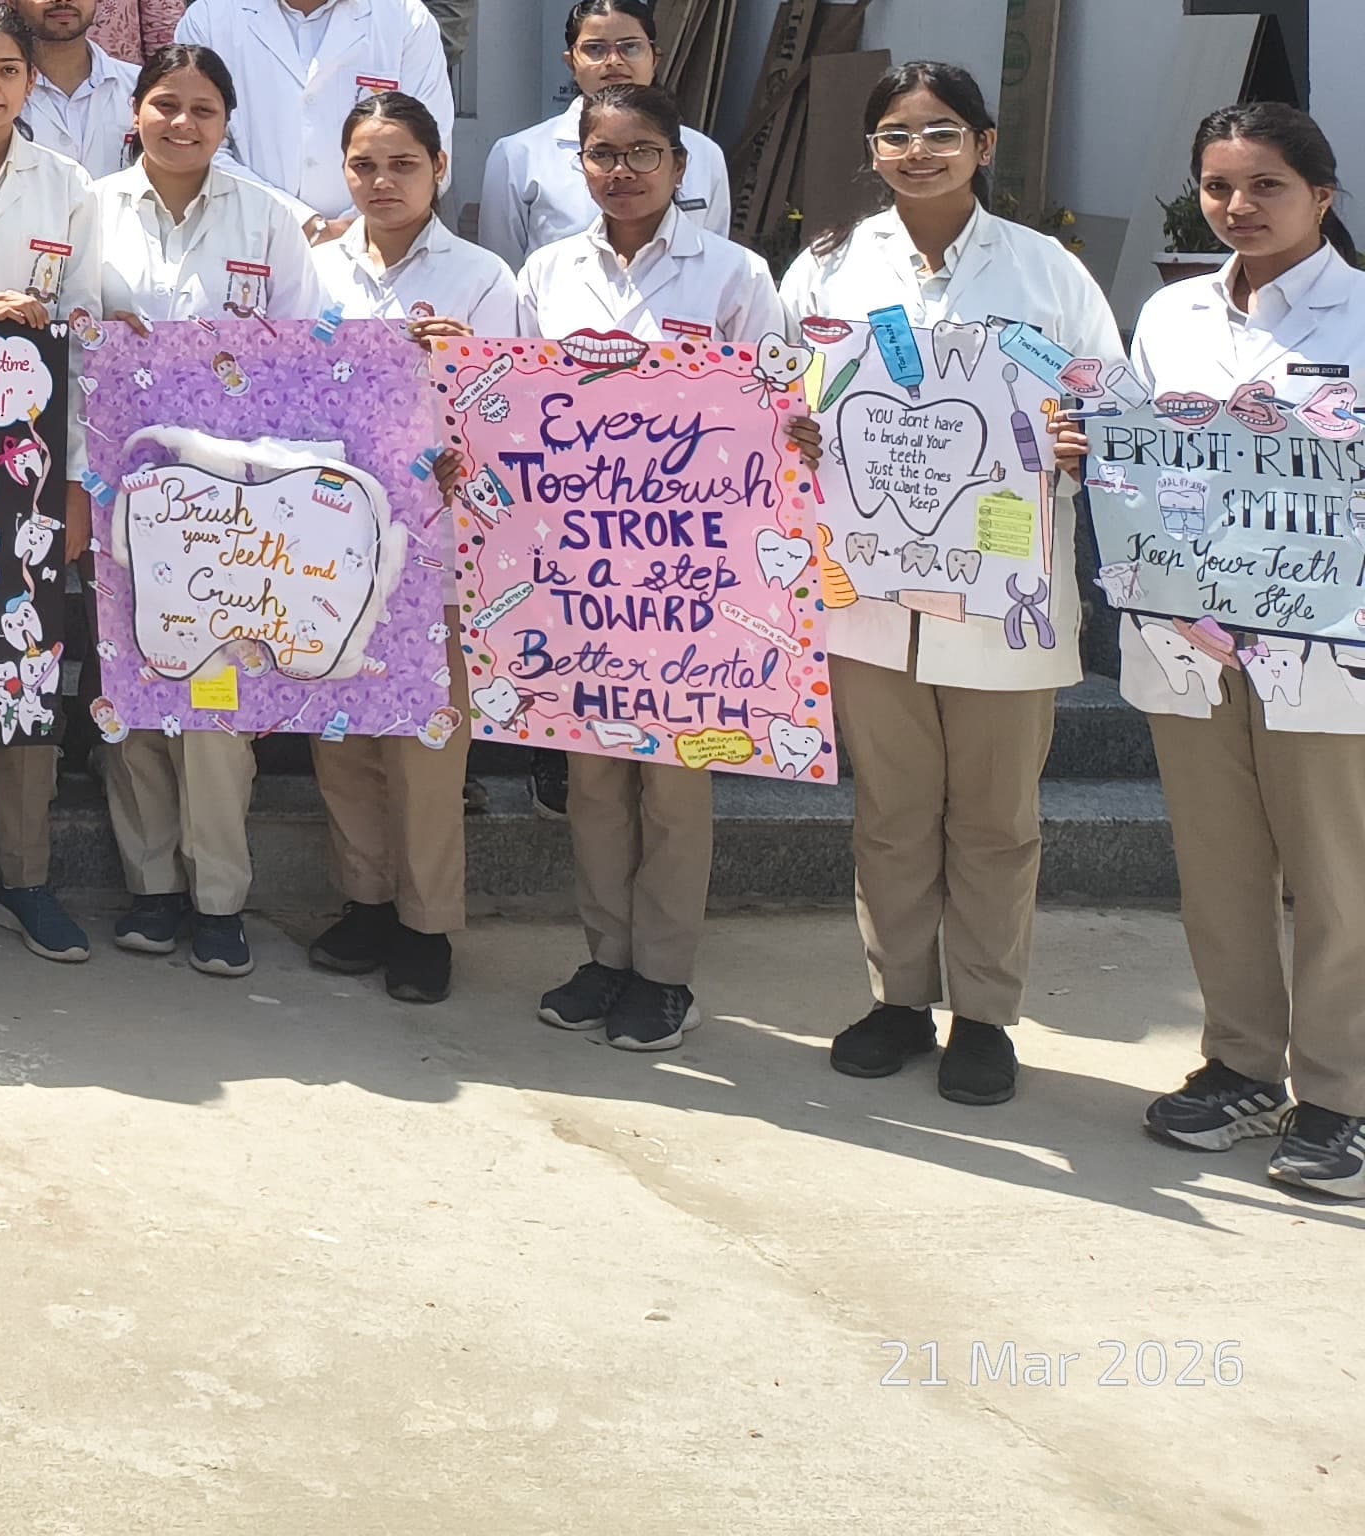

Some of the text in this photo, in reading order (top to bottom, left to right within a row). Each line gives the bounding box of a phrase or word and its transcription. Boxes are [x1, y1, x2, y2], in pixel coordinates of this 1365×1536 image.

[893, 346, 908, 373] TOOTH
[1018, 336, 1041, 357] TOOTH
[481, 395, 500, 412] CLEAN
[866, 407, 963, 433] YOU dont have
[539, 393, 735, 474] Every
[863, 427, 876, 441] to
[880, 427, 908, 446] brush
[910, 434, 923, 447] all
[889, 447, 926, 464] teeth
[1102, 426, 1232, 472] BRUSH
[498, 452, 776, 507] Toothbrush
[865, 460, 951, 482] Just the Ones
[923, 483, 938, 496] to
[155, 476, 256, 527] Brush
[909, 495, 940, 513] Keep
[1222, 489, 1344, 538] SMILE
[559, 509, 728, 551] STROKE
[181, 526, 338, 581] your Teeth and
[532, 546, 741, 602] is a step
[1127, 532, 1339, 586] Keep Your Teeth
[187, 567, 287, 619] Crush
[550, 588, 715, 632] TOWARD
[1198, 581, 1315, 628] In Style
[159, 609, 324, 665] your Cavity
[724, 605, 740, 618] SAY
[752, 621, 769, 634] WITH
[508, 629, 778, 691] Better dental
[572, 681, 751, 730] HEALTH
